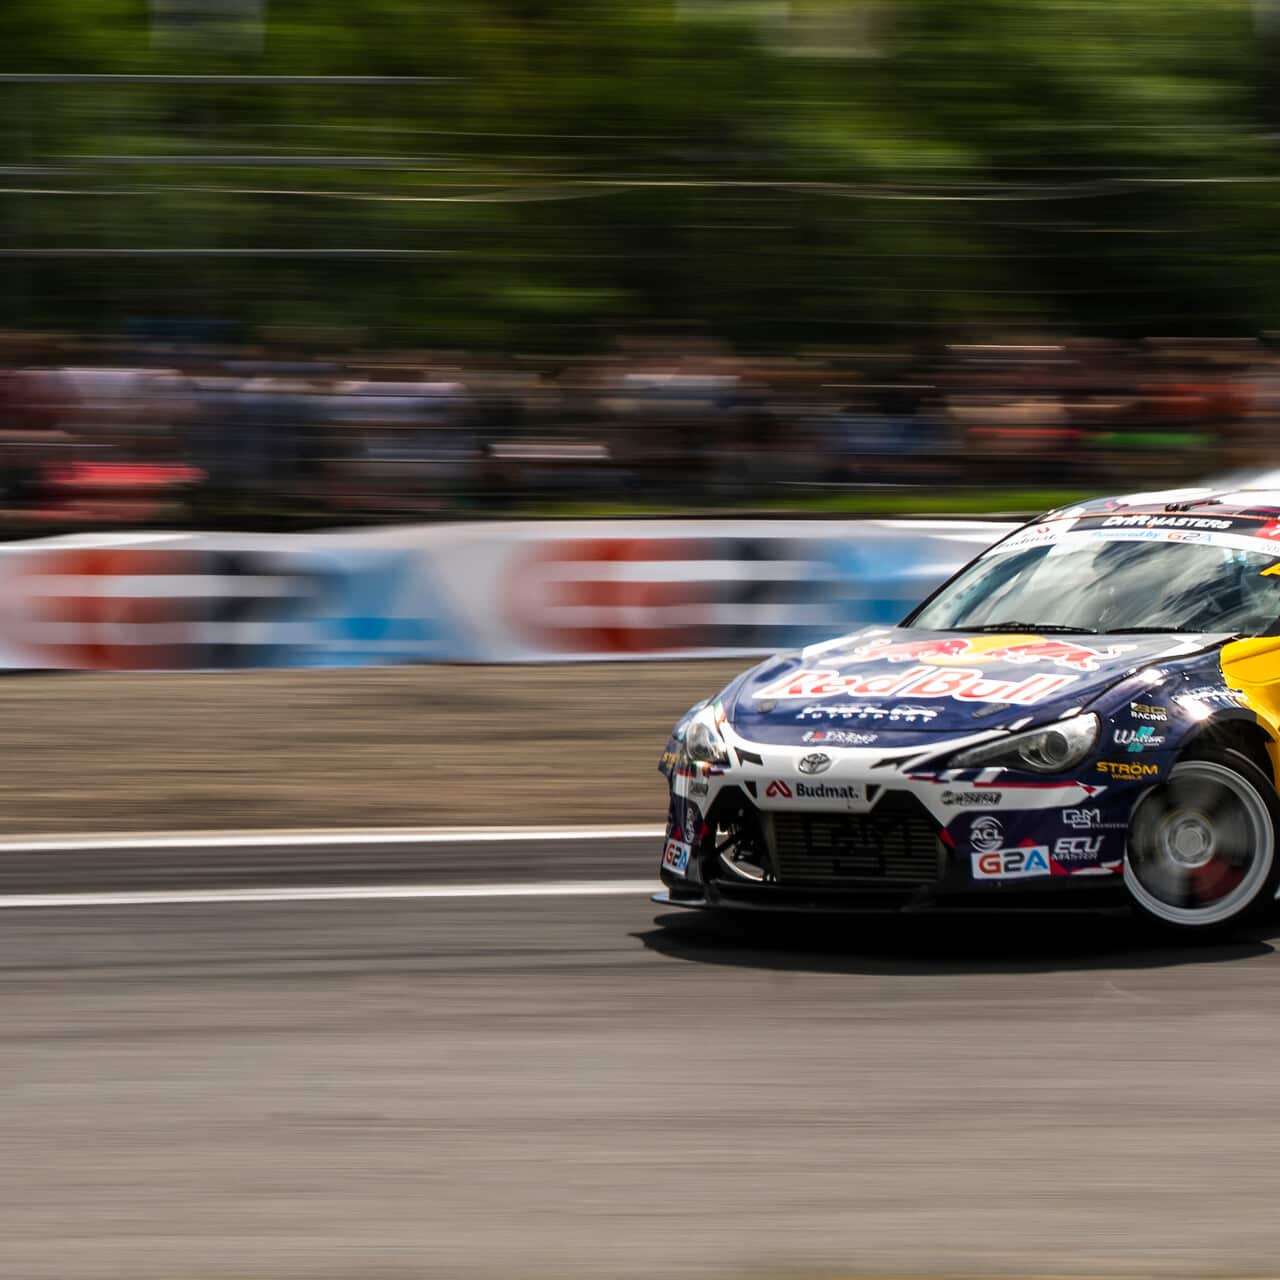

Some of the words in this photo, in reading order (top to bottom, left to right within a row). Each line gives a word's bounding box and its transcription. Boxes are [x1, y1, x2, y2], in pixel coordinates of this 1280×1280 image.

[1167, 532, 1213, 543] G2A
[752, 666, 924, 699] Red
[897, 666, 1079, 705] Bull
[1131, 711, 1168, 721] RACING
[1096, 760, 1158, 775] STRÖM
[796, 782, 860, 800] Budmat.
[970, 828, 1004, 840] ACL
[1054, 835, 1105, 853] ECU
[979, 849, 1049, 874] G2A
